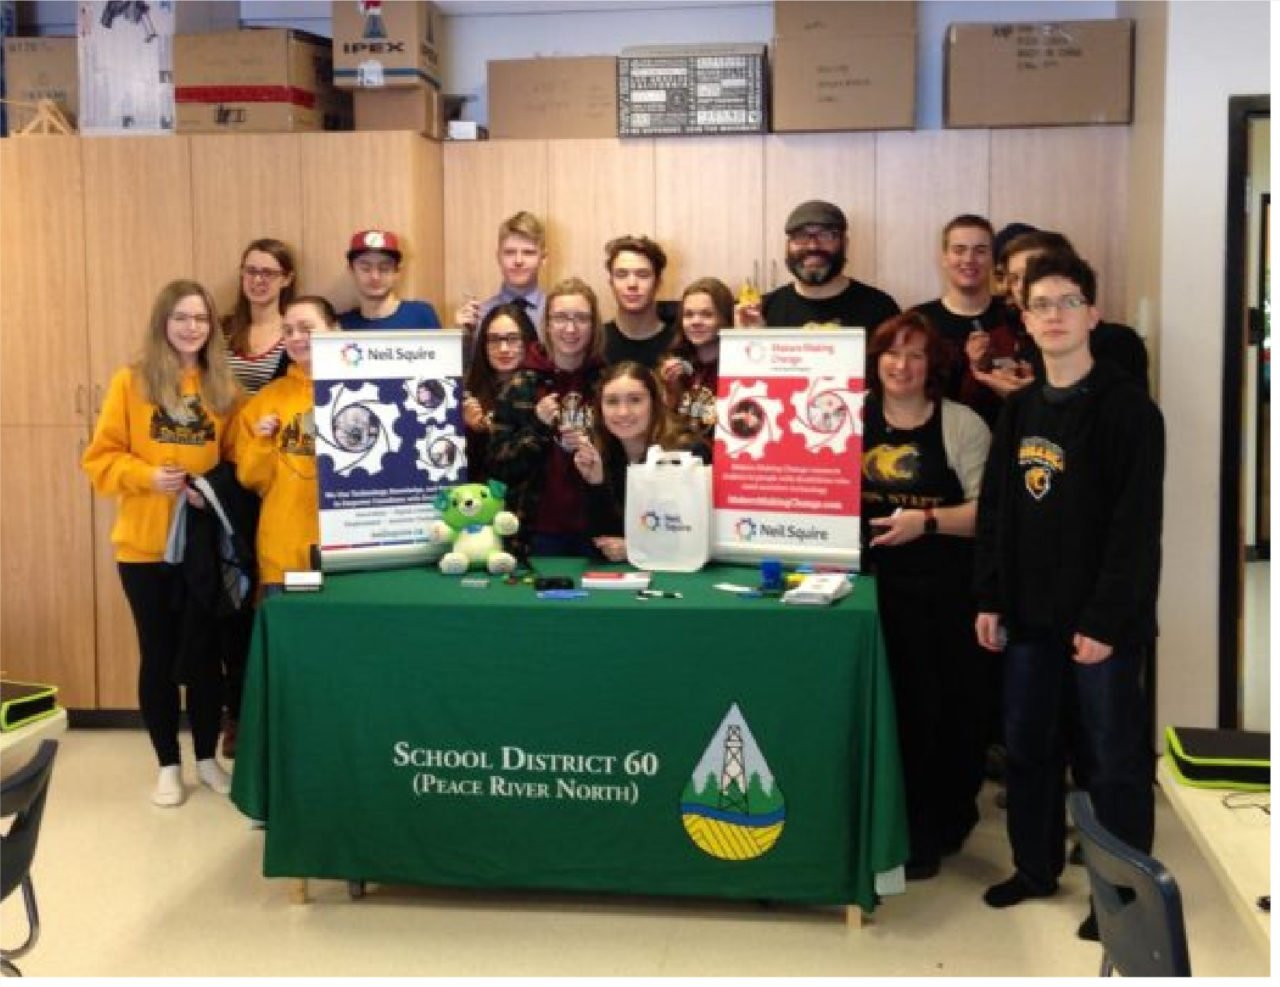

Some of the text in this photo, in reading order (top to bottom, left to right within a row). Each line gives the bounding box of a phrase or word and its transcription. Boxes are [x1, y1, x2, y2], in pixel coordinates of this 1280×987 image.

[343, 42, 404, 54] IPEX
[368, 347, 436, 363] Neil Squire
[760, 524, 829, 543] Neil Squire
[623, 751, 660, 776] 60
